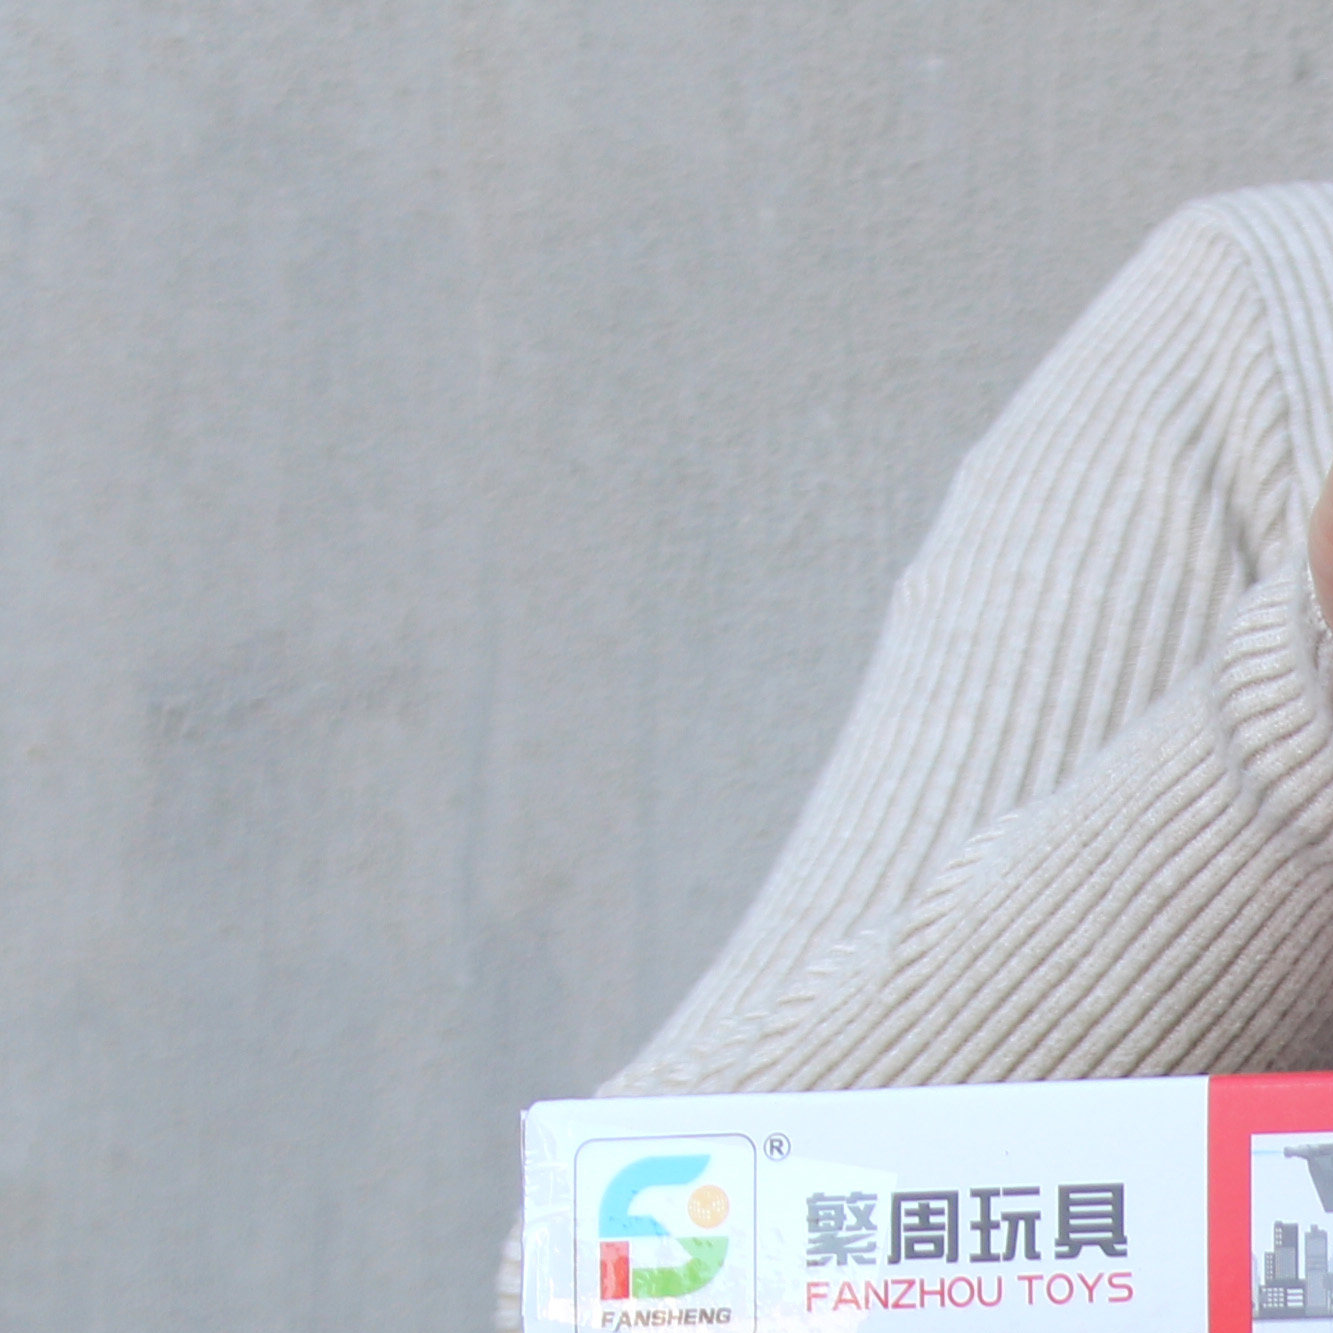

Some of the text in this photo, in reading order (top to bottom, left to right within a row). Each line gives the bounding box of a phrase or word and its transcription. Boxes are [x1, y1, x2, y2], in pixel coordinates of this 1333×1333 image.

[805, 1183, 1128, 1267] 繁周玩具
[806, 1272, 1134, 1312] FANZHOU TOYS
[601, 1307, 732, 1332] FANSHENG
